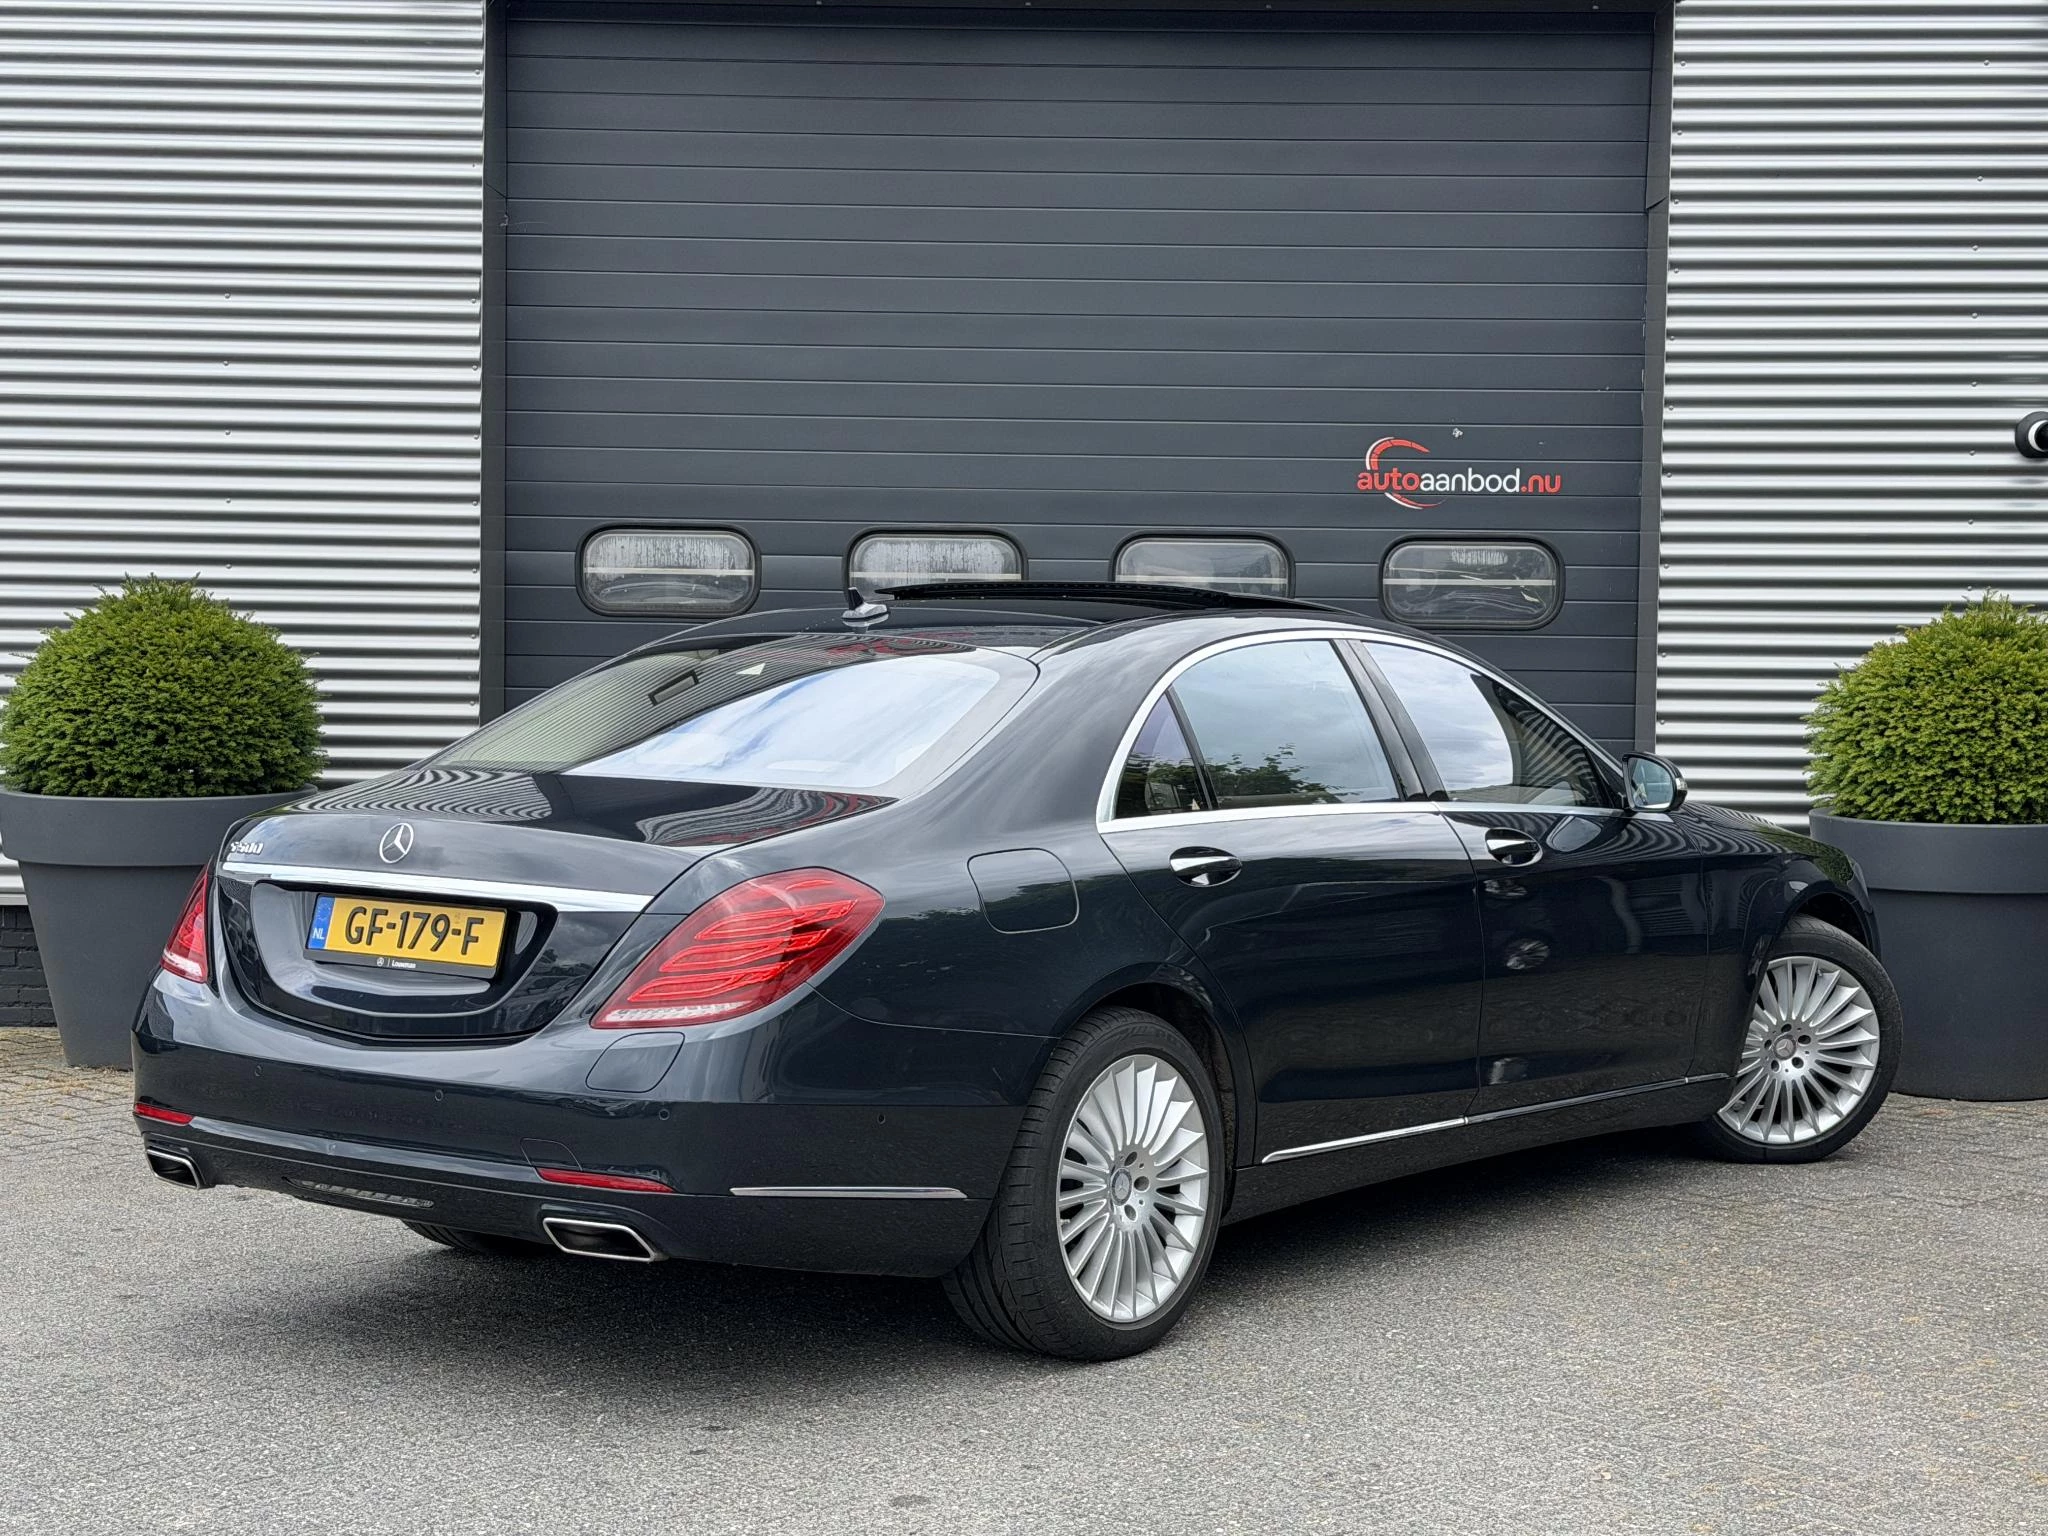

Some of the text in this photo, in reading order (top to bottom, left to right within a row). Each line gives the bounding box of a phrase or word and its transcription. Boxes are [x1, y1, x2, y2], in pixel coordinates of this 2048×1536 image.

[1356, 467, 1562, 493] autoaanbod.nu
[312, 927, 325, 941] NL
[344, 906, 485, 956] GF-179-F
